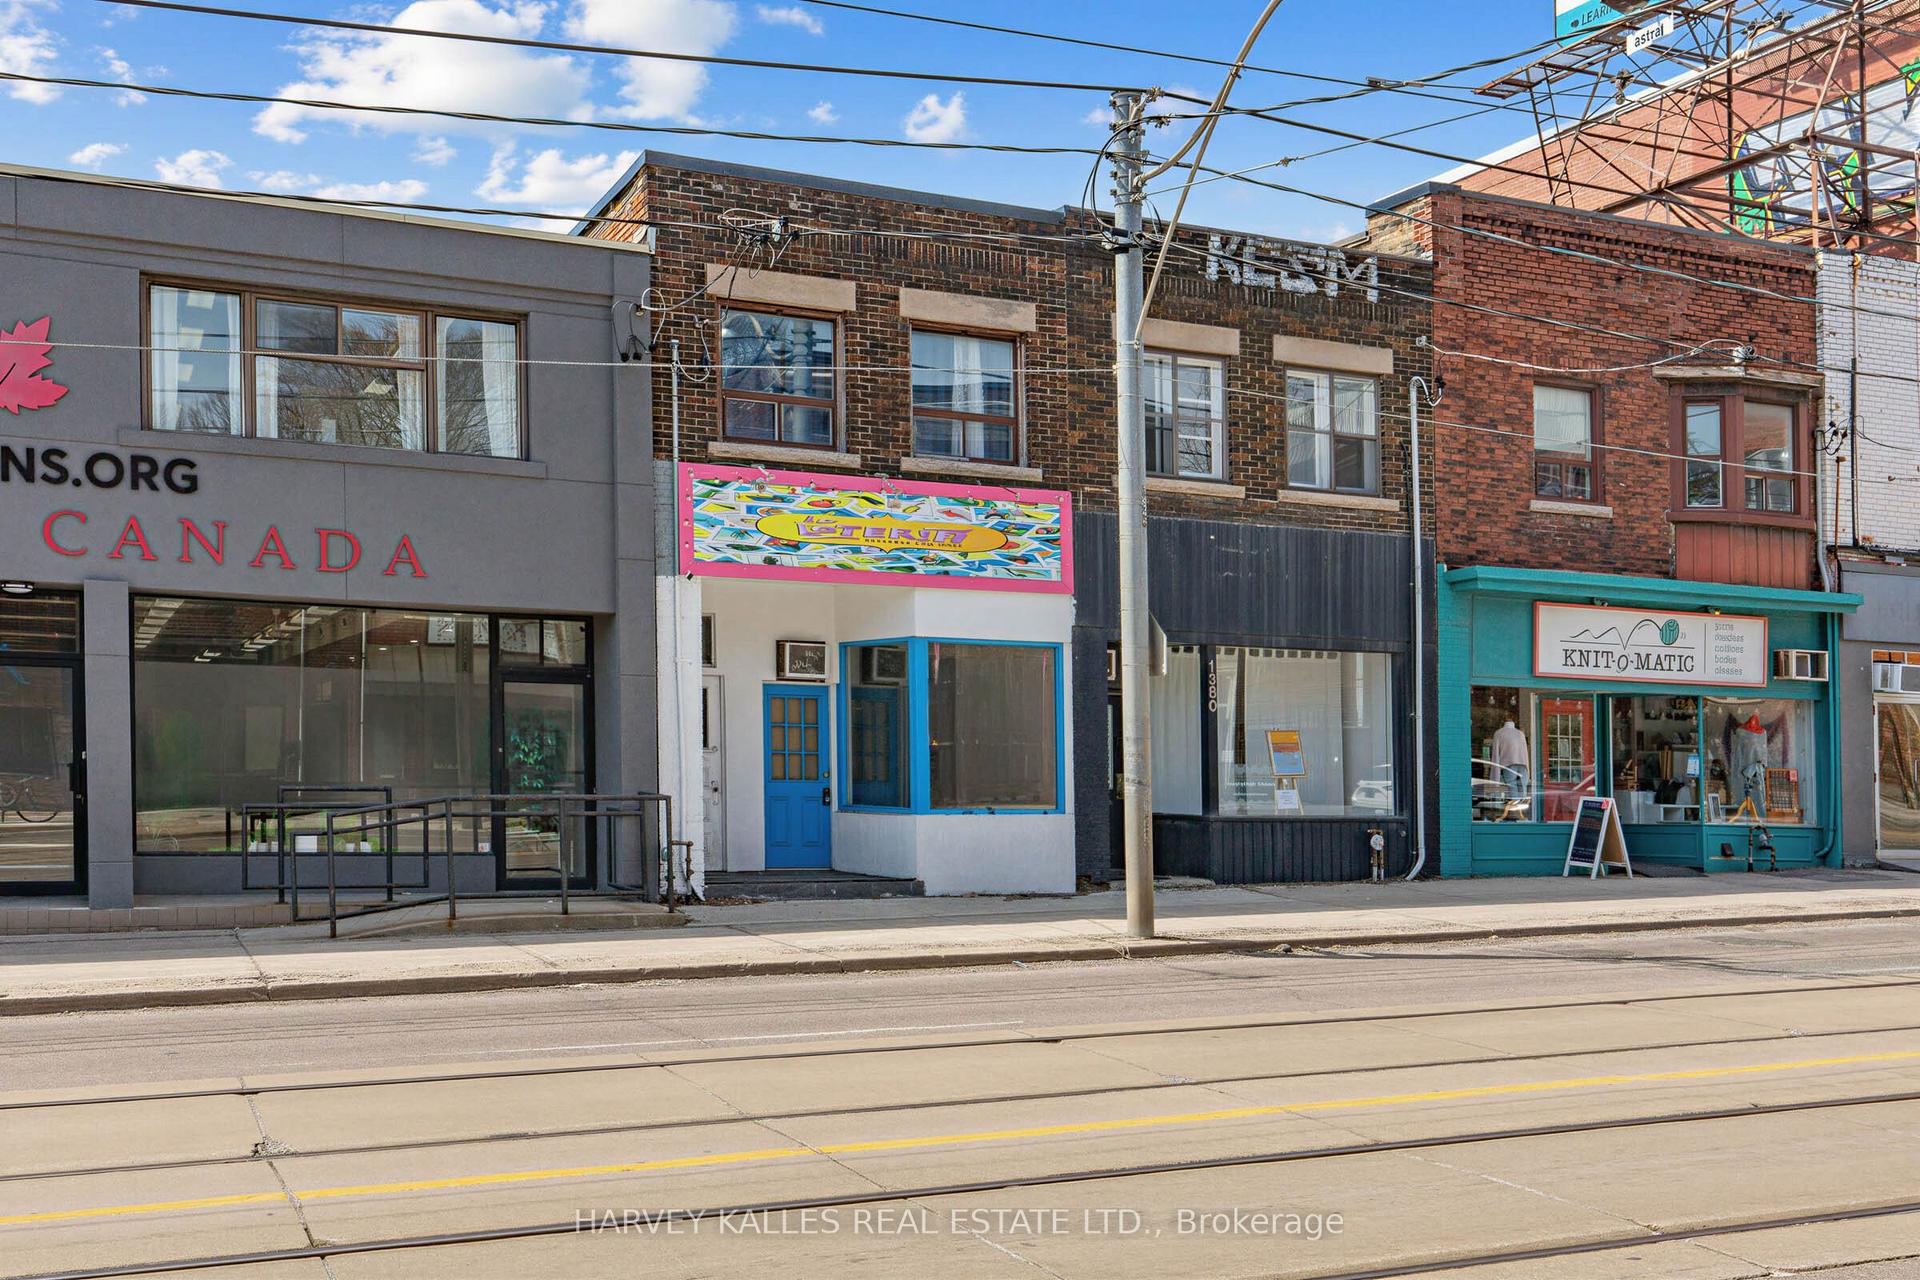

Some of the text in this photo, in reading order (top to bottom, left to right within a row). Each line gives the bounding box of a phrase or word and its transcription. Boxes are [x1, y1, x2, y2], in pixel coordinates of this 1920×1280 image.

[1634, 23, 1665, 48] astral
[0, 445, 198, 495] NS.ORG
[42, 510, 429, 578] CANADA
[1208, 659, 1217, 713] 1380
